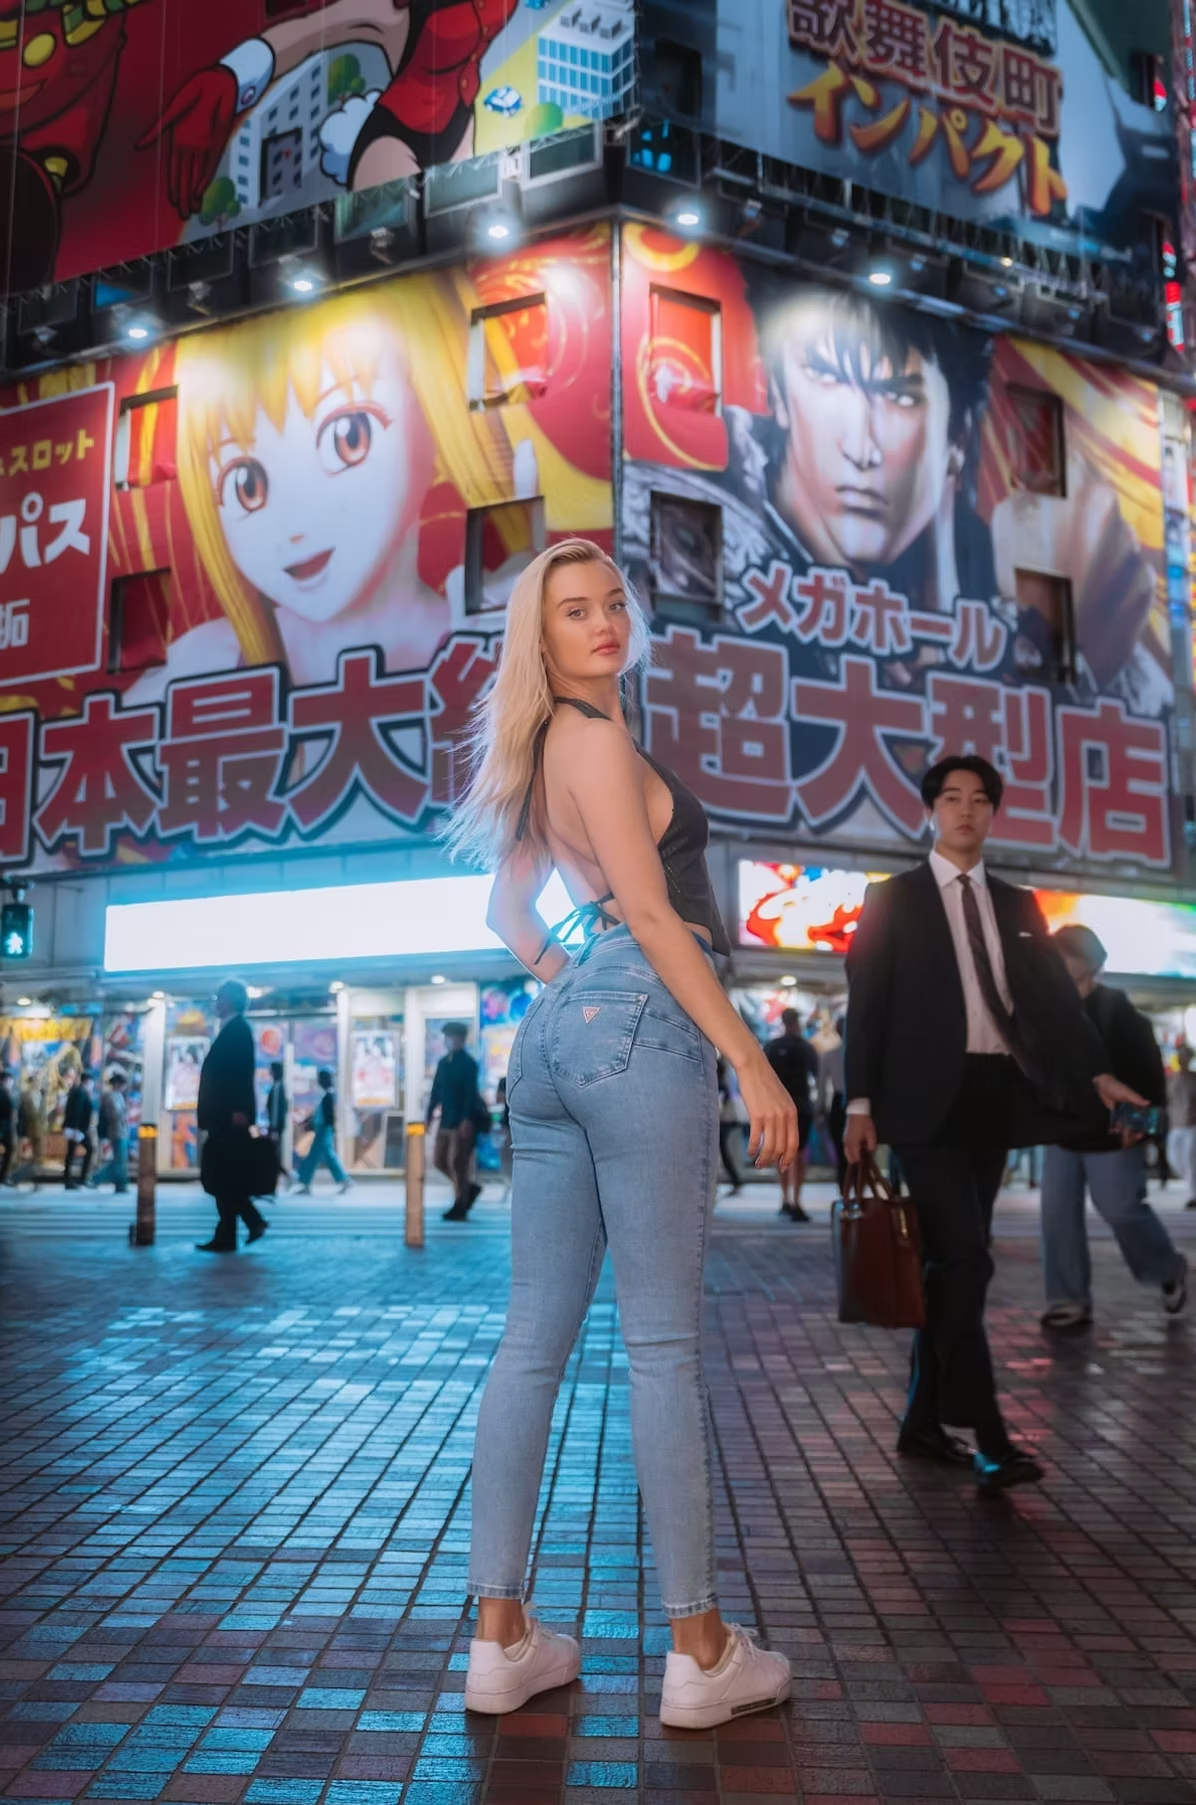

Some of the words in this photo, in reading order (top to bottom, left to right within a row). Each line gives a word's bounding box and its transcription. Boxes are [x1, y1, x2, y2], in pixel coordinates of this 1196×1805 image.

[786, 60, 1069, 216] インパクト
[0, 429, 95, 478] スロット
[736, 560, 1008, 672] メガホール
[644, 625, 1173, 868] 超大型店
